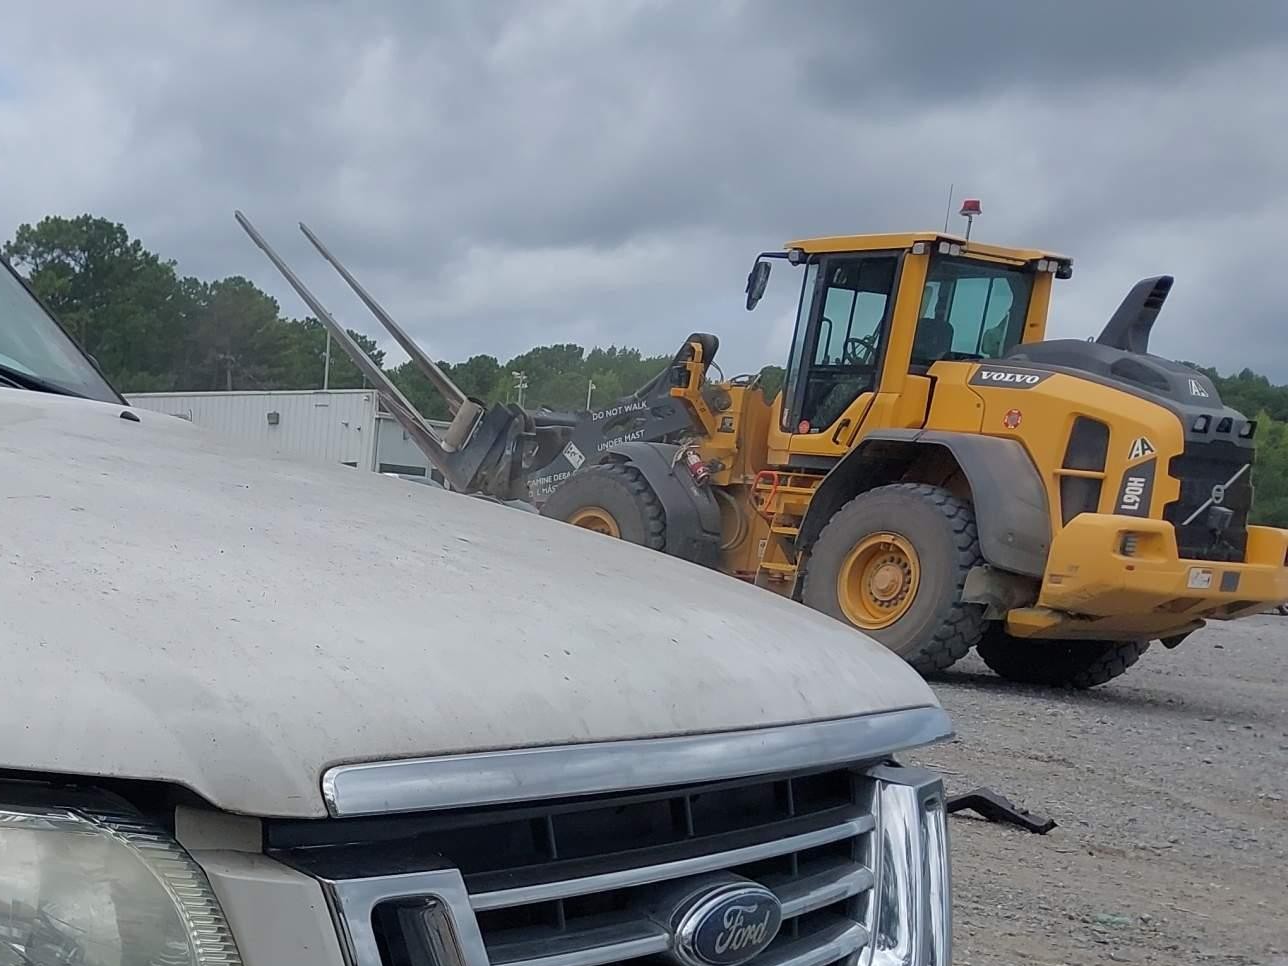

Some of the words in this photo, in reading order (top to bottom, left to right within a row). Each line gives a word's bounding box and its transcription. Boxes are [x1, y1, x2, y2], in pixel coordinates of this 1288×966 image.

[981, 371, 1040, 384] VOLVO
[592, 412, 605, 421] DO
[605, 406, 622, 418] NOT
[624, 400, 647, 412] WALK
[597, 437, 623, 451] UNDER
[624, 429, 645, 442] MAST
[1120, 476, 1146, 510] L90H
[714, 903, 770, 954] Ford
